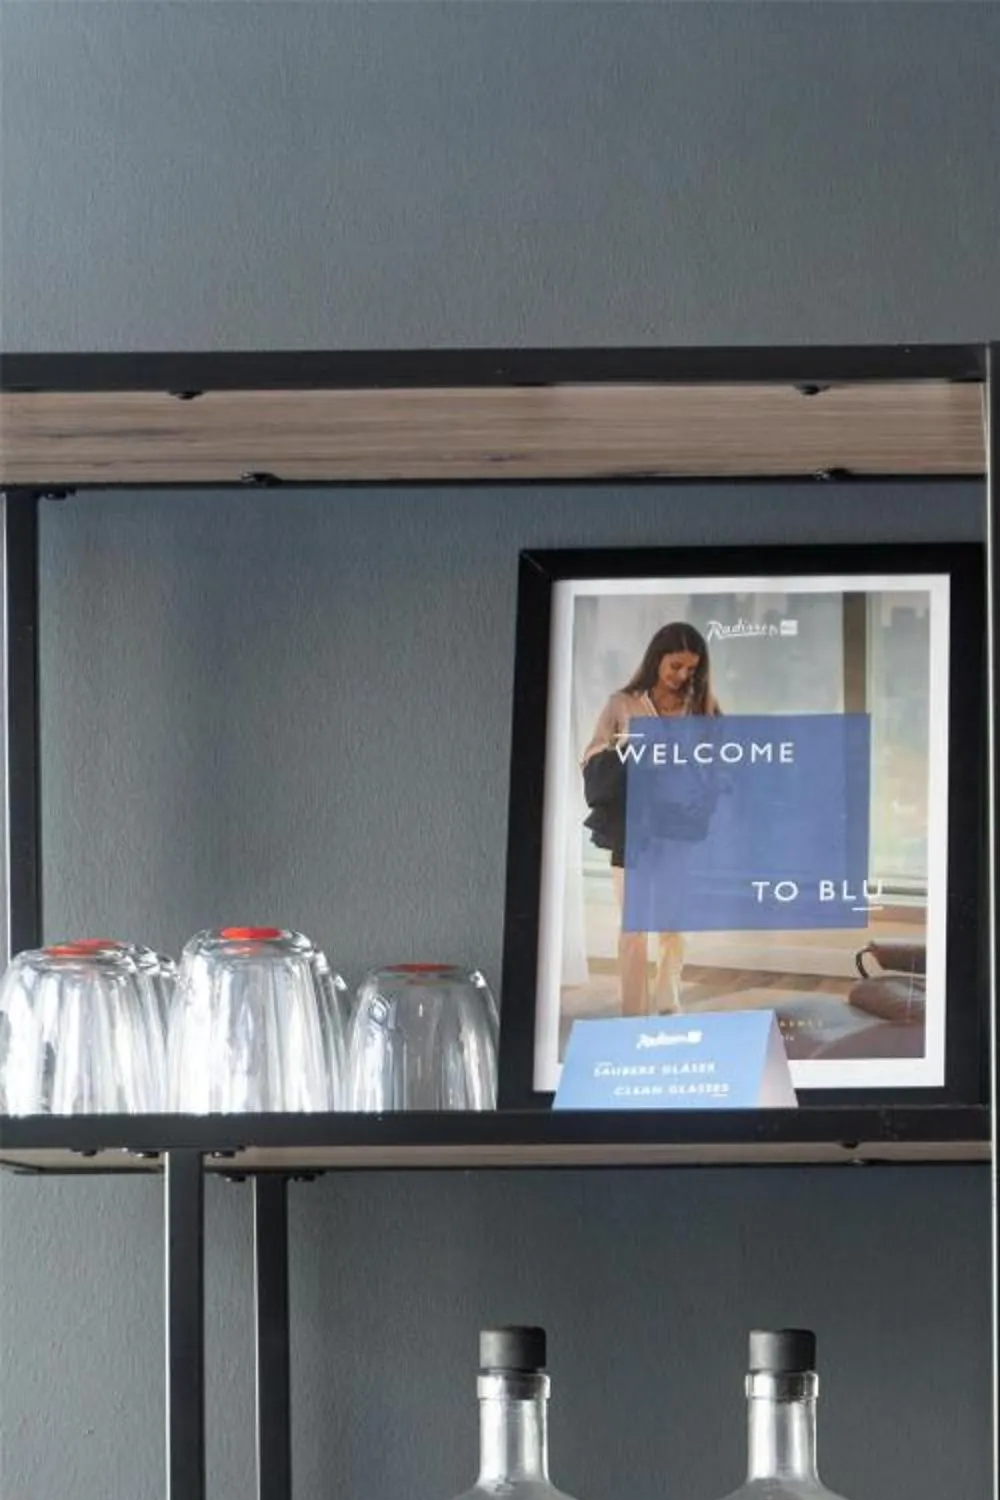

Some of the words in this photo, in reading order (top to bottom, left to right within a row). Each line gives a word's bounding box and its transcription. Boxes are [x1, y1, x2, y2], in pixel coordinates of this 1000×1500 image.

[614, 741, 796, 765] WELCOME
[752, 881, 798, 902] TO
[819, 879, 884, 901] BLU
